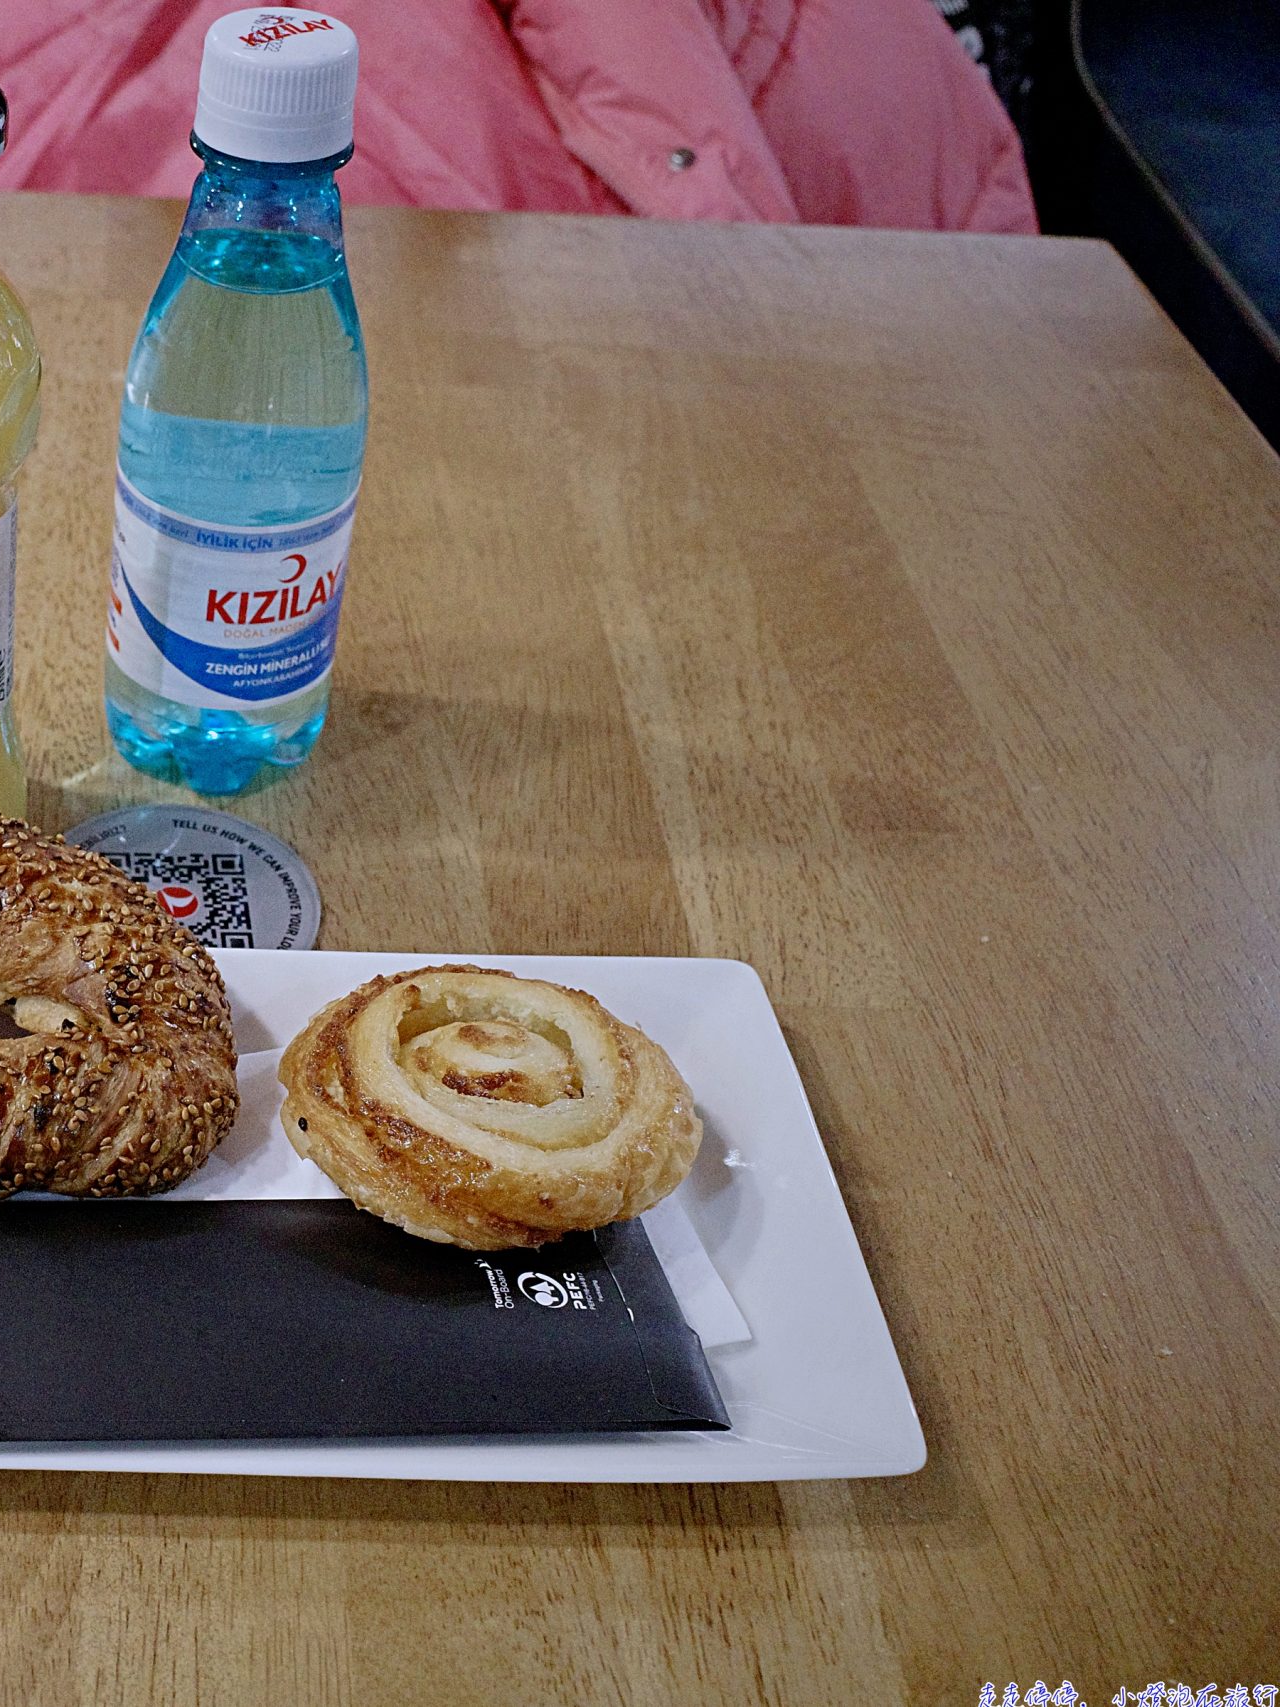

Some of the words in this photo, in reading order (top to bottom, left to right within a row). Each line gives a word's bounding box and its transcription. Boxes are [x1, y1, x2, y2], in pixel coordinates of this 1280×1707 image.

[238, 19, 334, 46] KIZILAY
[196, 532, 239, 549] İYİLİK
[242, 535, 273, 551] İÇİN
[205, 559, 344, 625] KIZILAY
[223, 627, 265, 639] DOĞAL
[205, 661, 258, 676] ZENGİN
[171, 819, 198, 831] TELL
[202, 823, 217, 834] US
[220, 829, 249, 845] HOW
[248, 841, 265, 856] WE
[263, 854, 284, 873] CAN
[279, 871, 302, 911] IMPROVE
[288, 912, 302, 937] YOUR
[485, 1269, 504, 1309] Tomorrow
[494, 1269, 515, 1309] On-Board
[562, 1272, 587, 1310] PEFC
